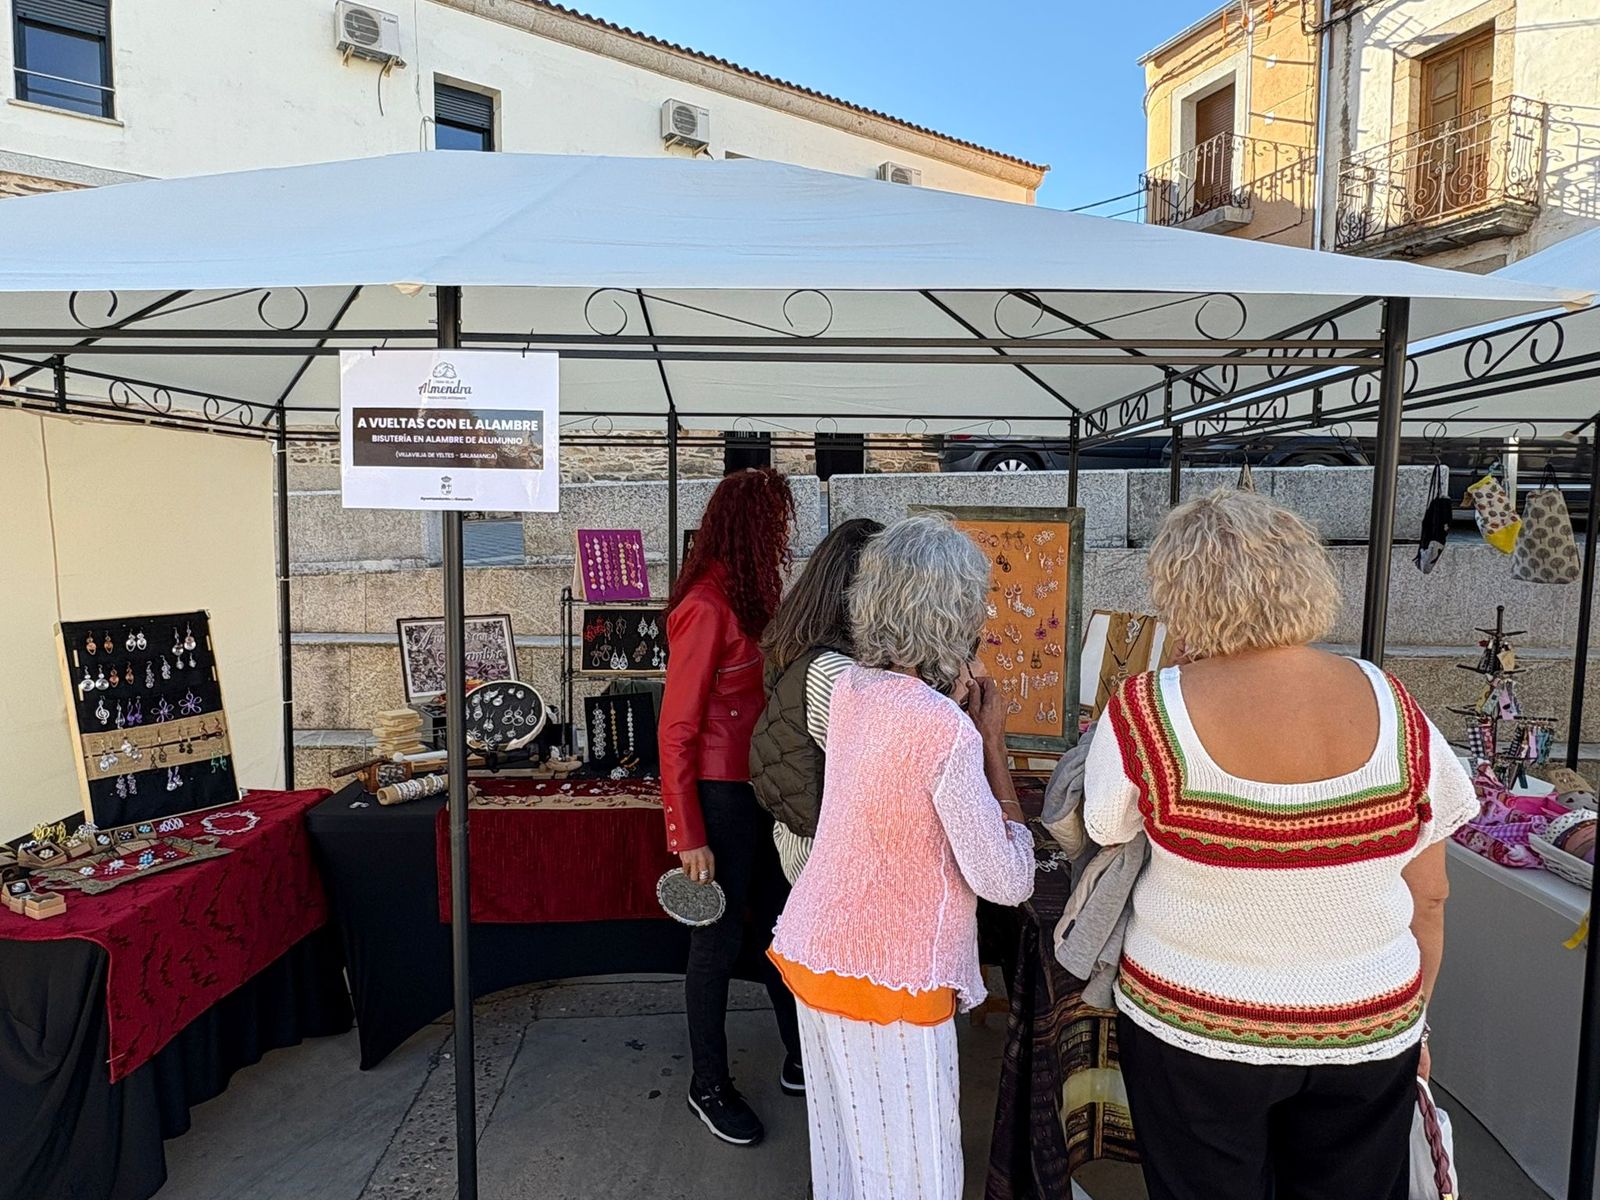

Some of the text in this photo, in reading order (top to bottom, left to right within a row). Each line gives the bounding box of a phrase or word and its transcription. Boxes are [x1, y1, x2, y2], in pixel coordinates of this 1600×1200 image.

[417, 379, 472, 395] Almendra
[357, 417, 539, 431] A VUELTAS CON EL ALAMBRE
[371, 433, 523, 445] BISUTERÍA EN ALAMBRE DE ALUMUNIO
[460, 452, 498, 460] SALAMANCA)
